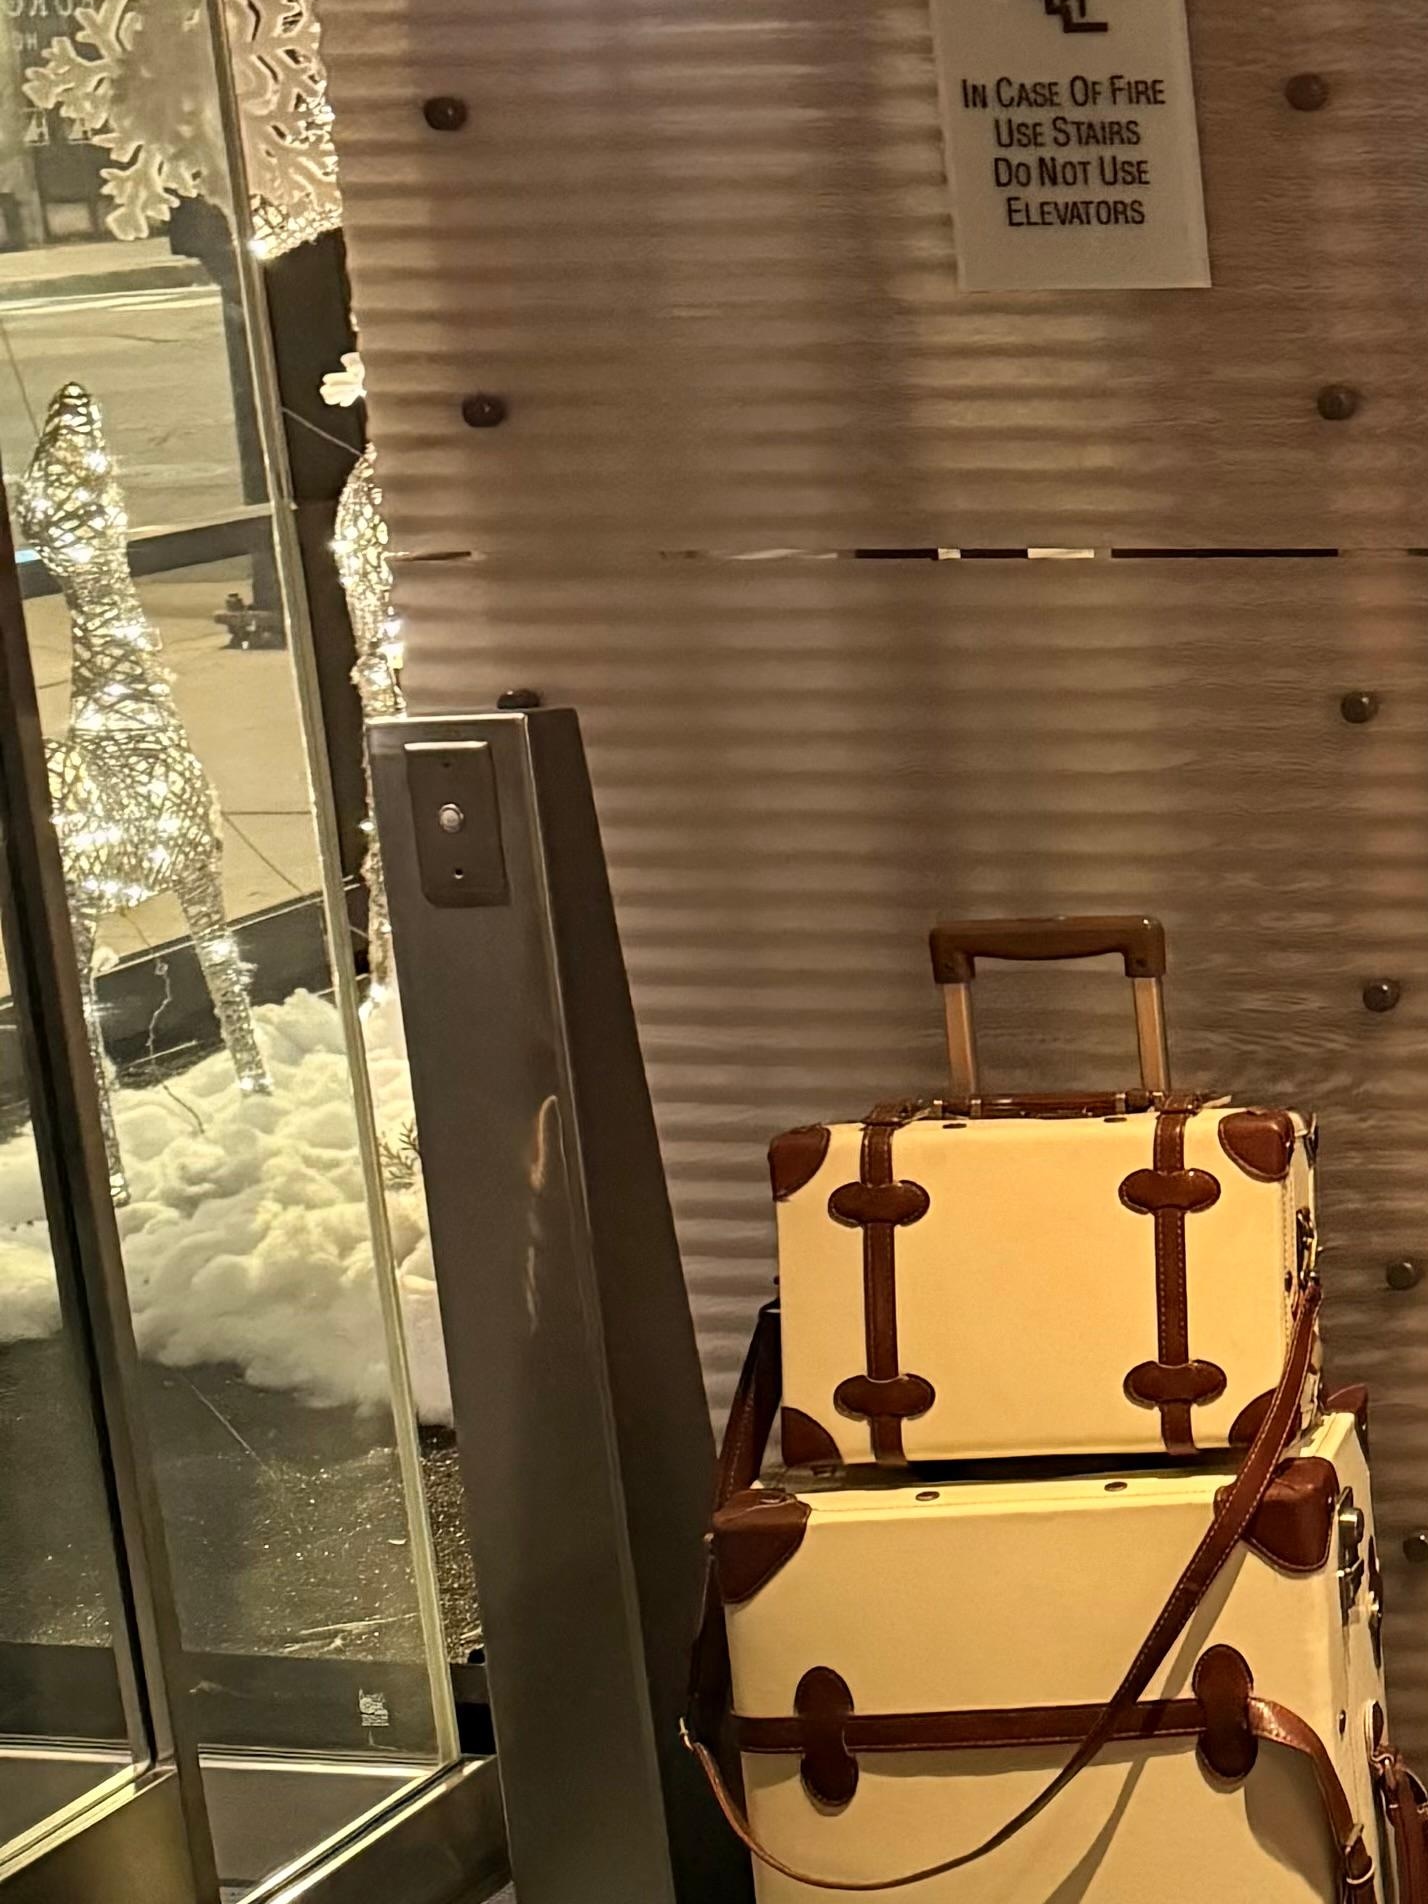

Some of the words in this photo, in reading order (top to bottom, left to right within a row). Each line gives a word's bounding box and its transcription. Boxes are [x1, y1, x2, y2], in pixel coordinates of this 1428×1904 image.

[961, 78, 989, 109] IN
[996, 76, 1062, 109] CASE
[1070, 75, 1103, 108] OF
[1110, 74, 1166, 106] FIRE
[994, 117, 1047, 148] USE
[1052, 116, 1142, 147] STAIRS
[994, 157, 1032, 188] DO
[1038, 156, 1092, 187] NOT
[1099, 155, 1150, 186] USE
[1007, 196, 1146, 227] ELEVATORS
